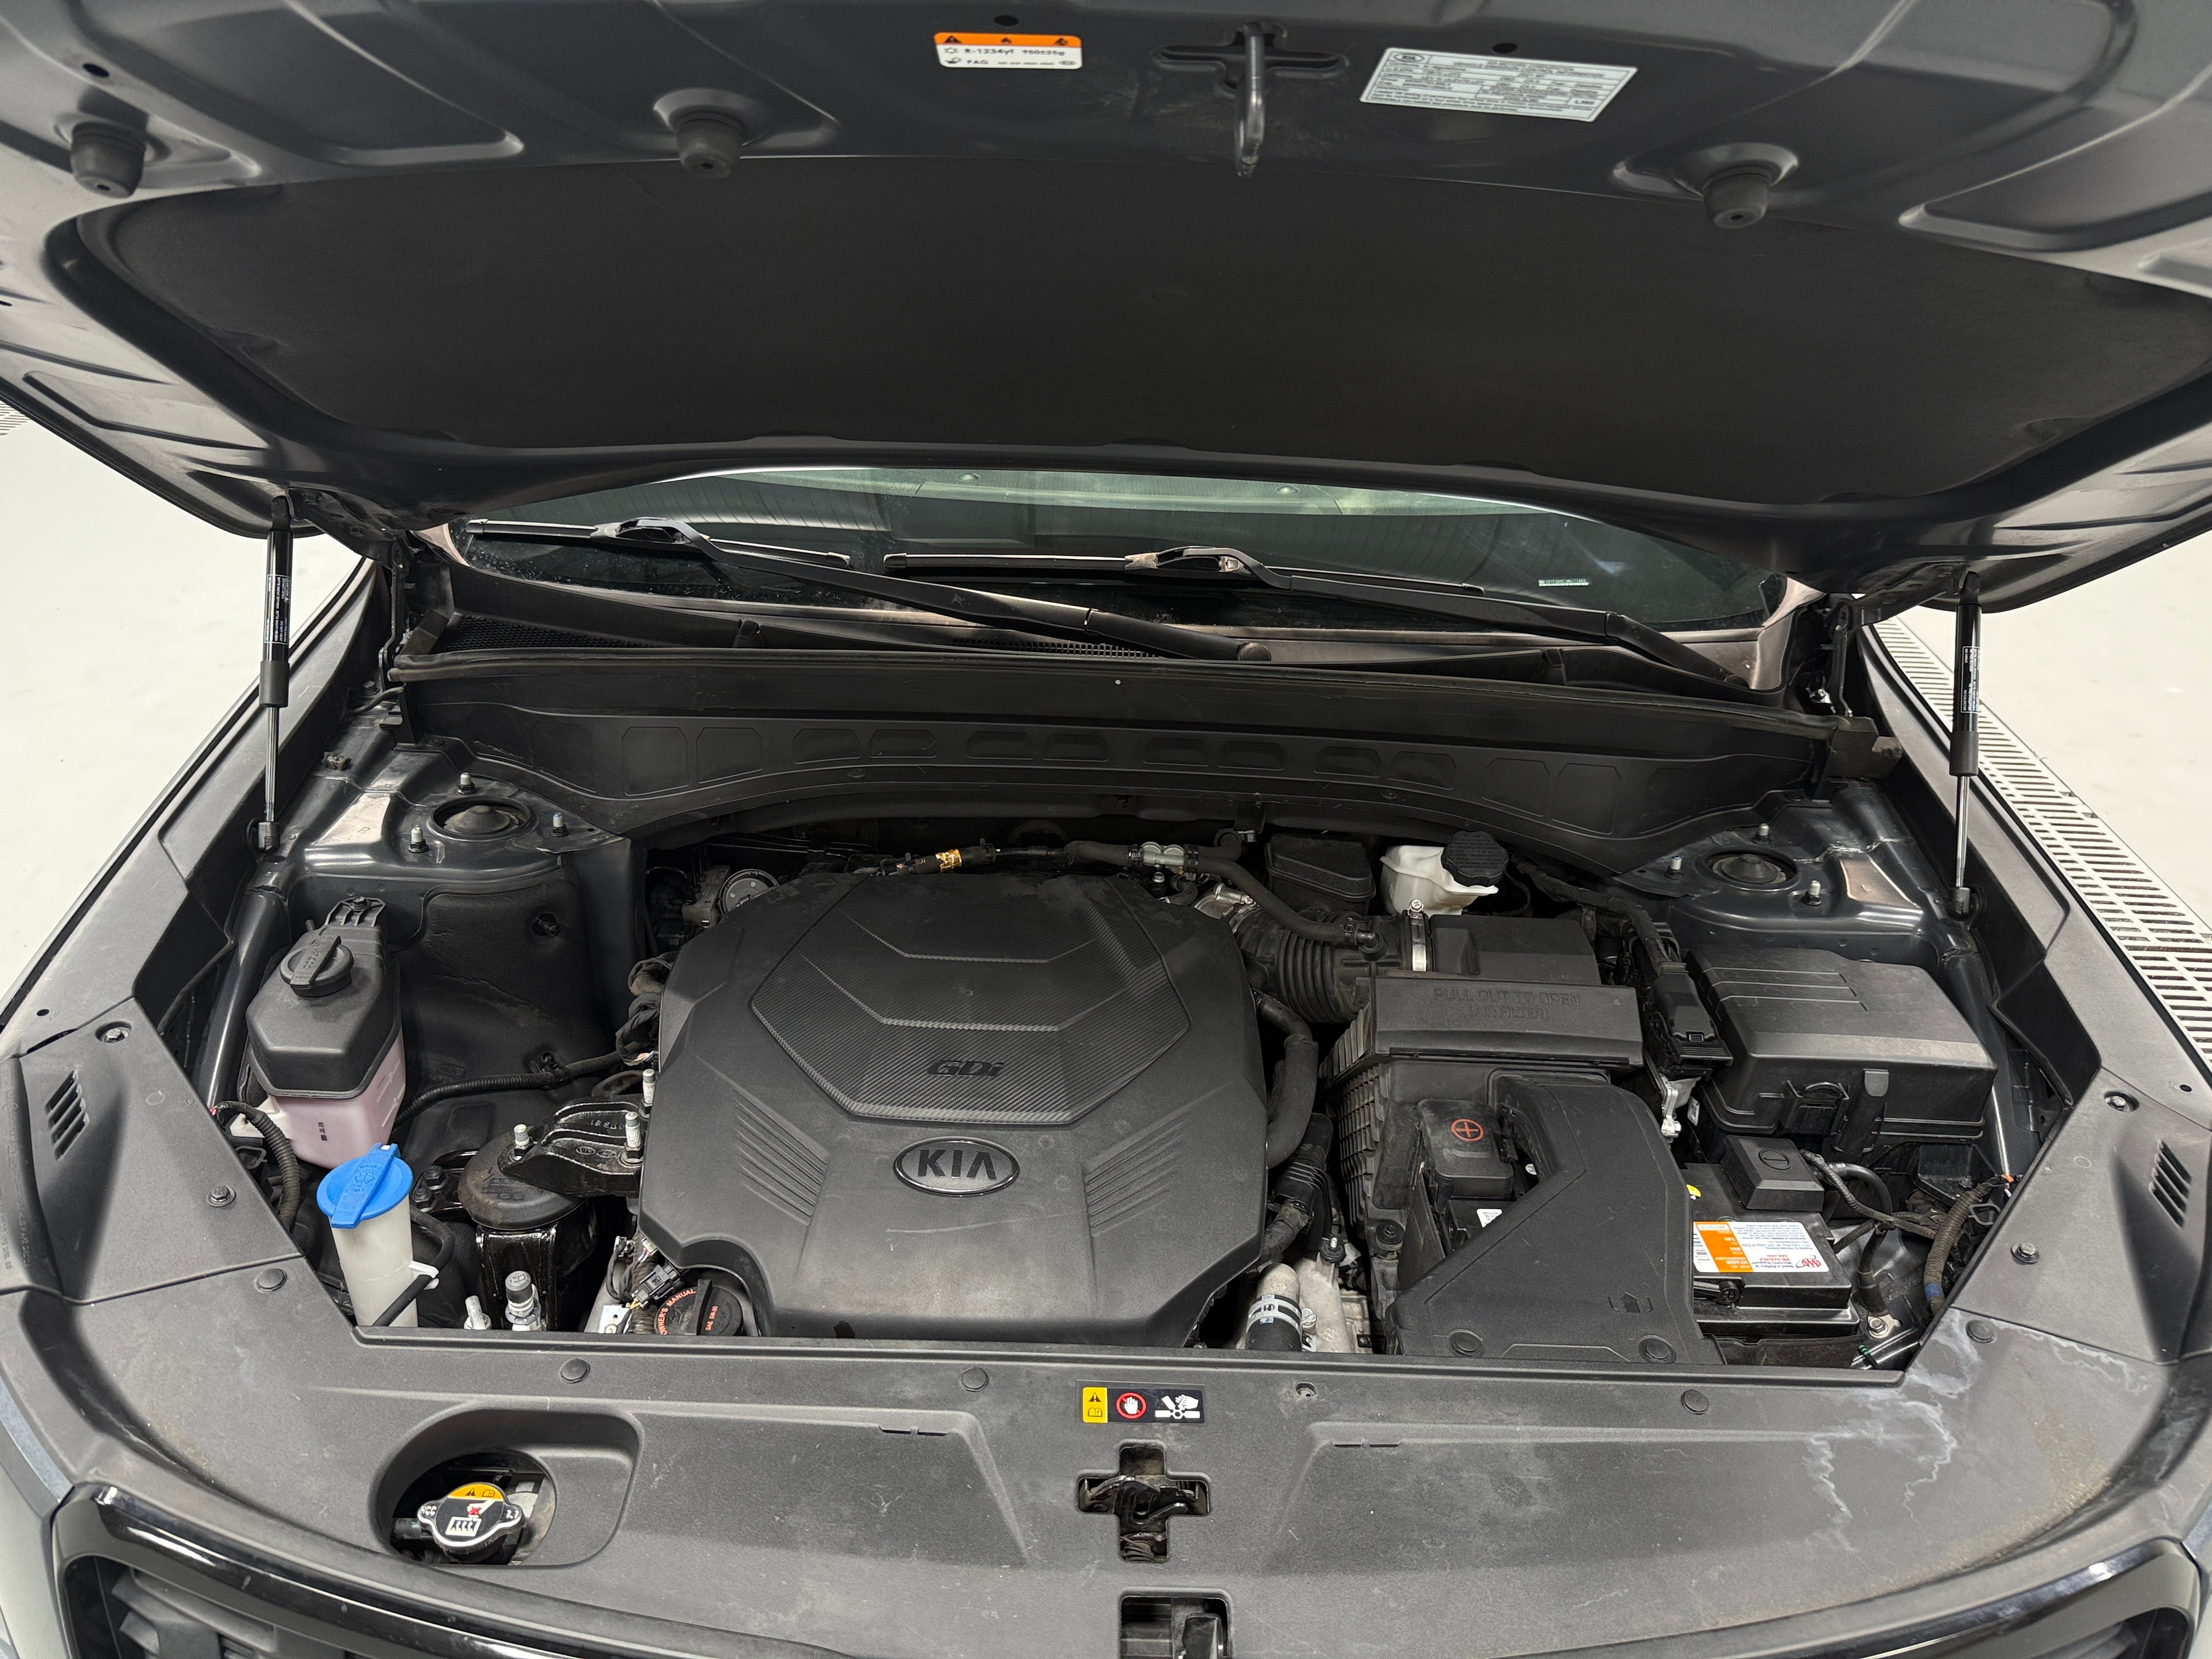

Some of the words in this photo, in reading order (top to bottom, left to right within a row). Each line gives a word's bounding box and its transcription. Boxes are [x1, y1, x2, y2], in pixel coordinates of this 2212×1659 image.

[1434, 988, 1474, 1001] PULL
[1479, 990, 1509, 1003] OUT
[1513, 991, 1534, 1005] TO
[1539, 992, 1581, 1006] OPEN
[927, 1060, 1005, 1077] GDi
[917, 1149, 997, 1181] KIA
[657, 1307, 669, 1335] OWNER'S
[665, 1288, 697, 1307] MANUAL
[705, 1320, 714, 1331] SAE
